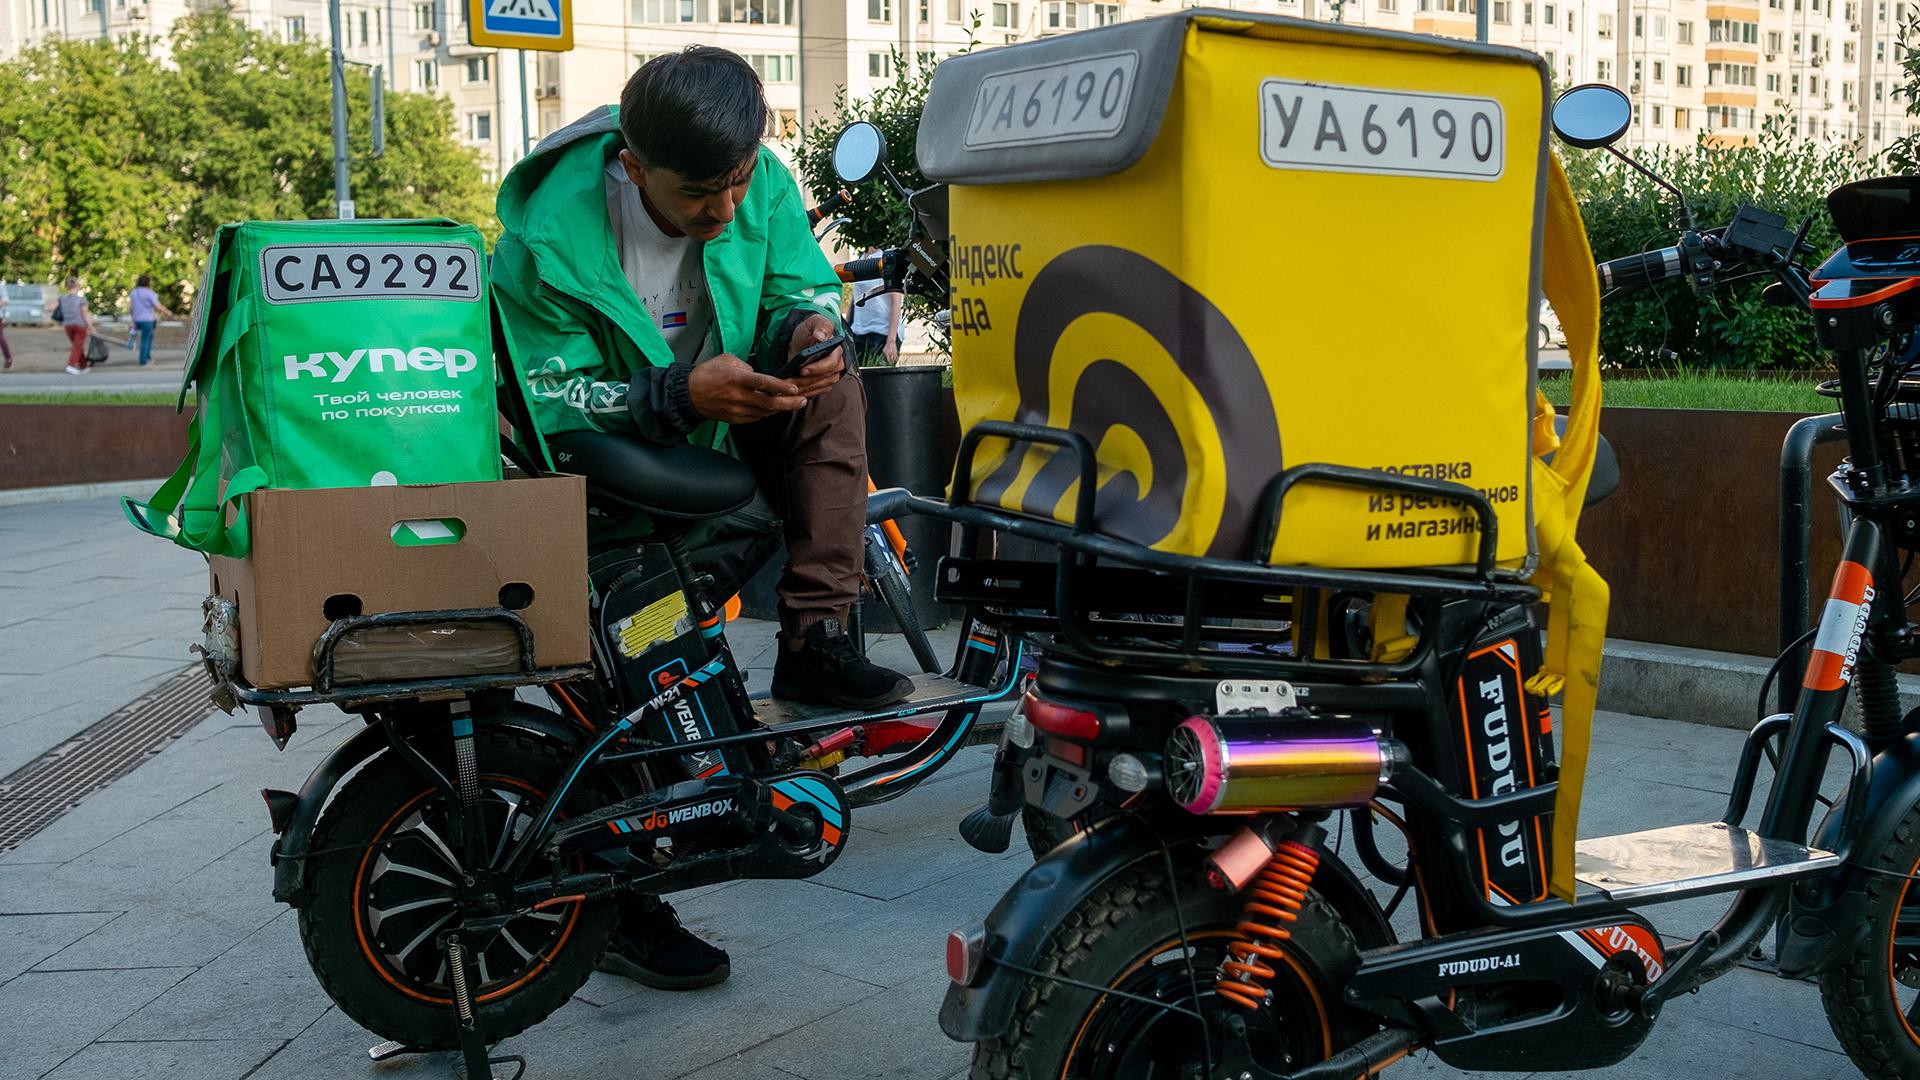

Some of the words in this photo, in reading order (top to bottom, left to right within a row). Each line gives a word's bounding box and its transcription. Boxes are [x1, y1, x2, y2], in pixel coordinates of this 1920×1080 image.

[975, 67, 1125, 134] УА6190
[1272, 93, 1493, 163] УА6190
[274, 253, 469, 292] СА9292
[283, 346, 478, 384] купер
[313, 391, 370, 406] Твой
[376, 388, 463, 401] человек
[321, 409, 349, 421] по
[356, 403, 460, 417] покупкам
[1368, 494, 1395, 513] из
[1366, 523, 1381, 541] и
[1840, 584, 1876, 684] FUDUDU
[649, 686, 682, 711] W-21
[1438, 953, 1521, 977] FUDUDU-A1
